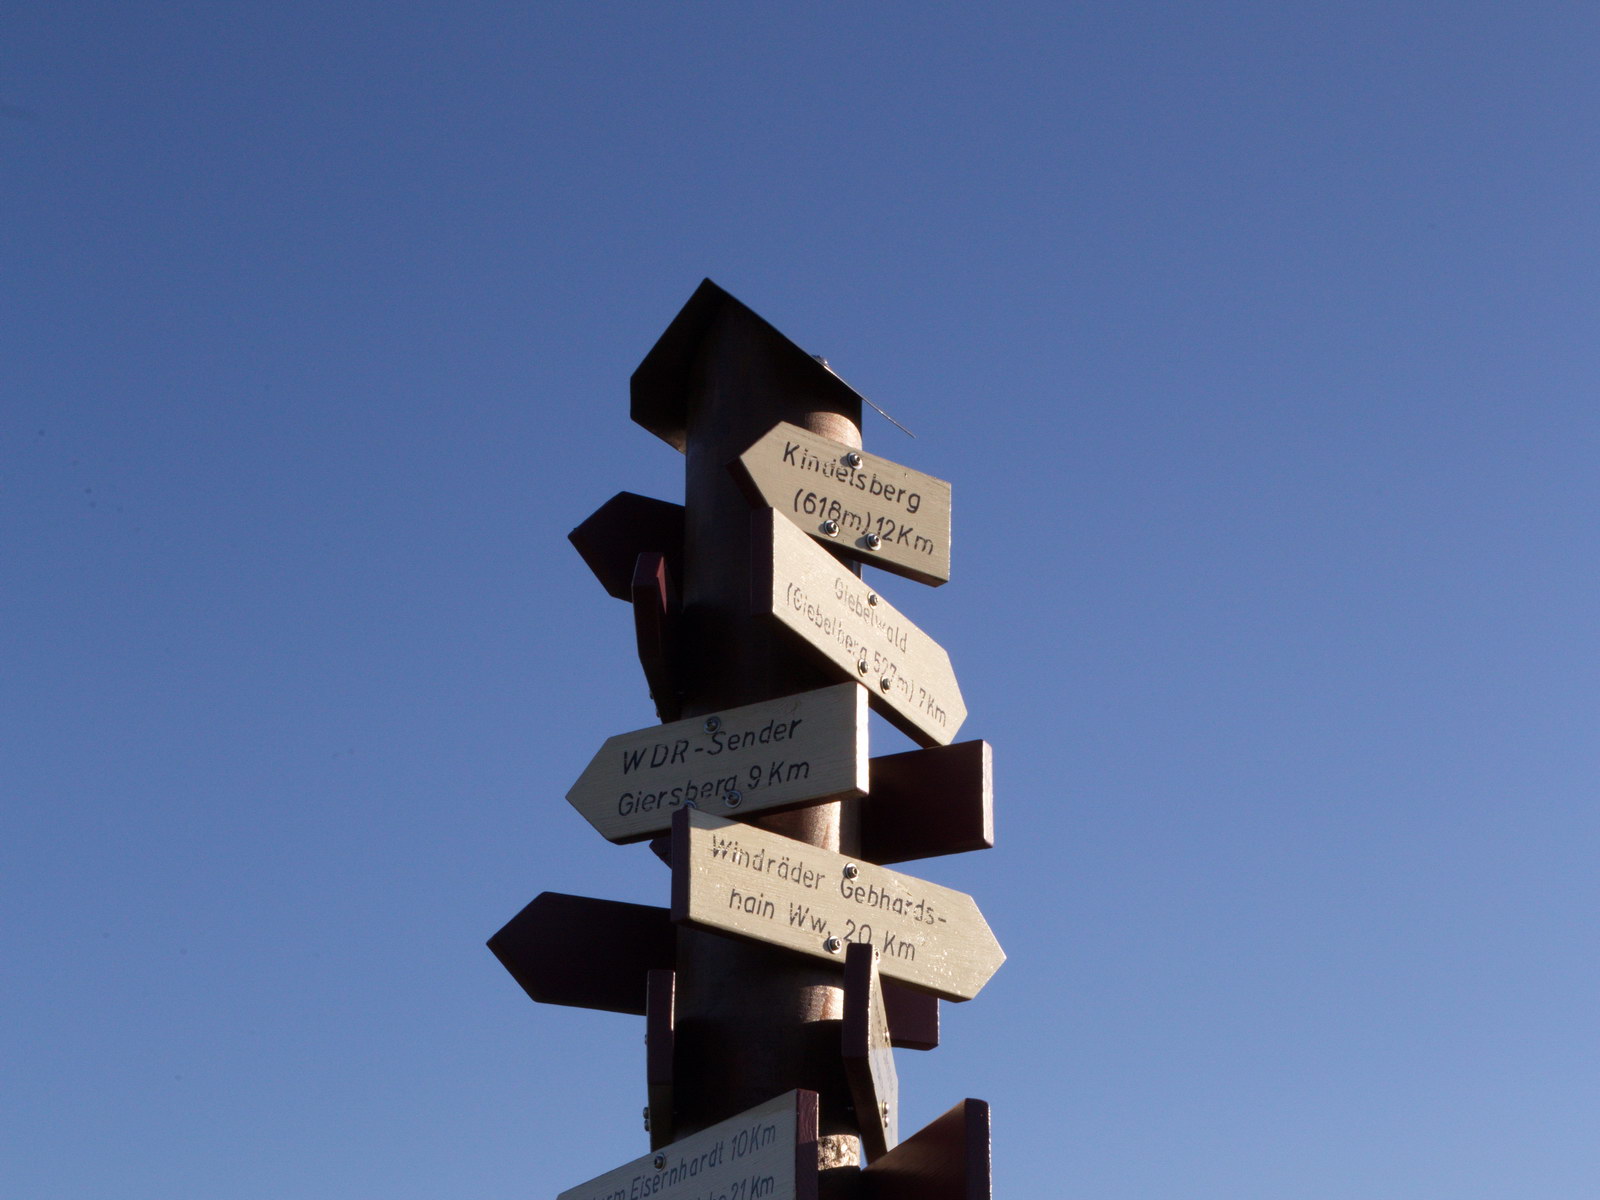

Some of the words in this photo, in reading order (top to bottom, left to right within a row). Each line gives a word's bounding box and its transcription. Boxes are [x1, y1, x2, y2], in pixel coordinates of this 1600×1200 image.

[618, 774, 737, 816] Giersberg
[711, 834, 825, 890] Windräder
[729, 888, 775, 919] hain
